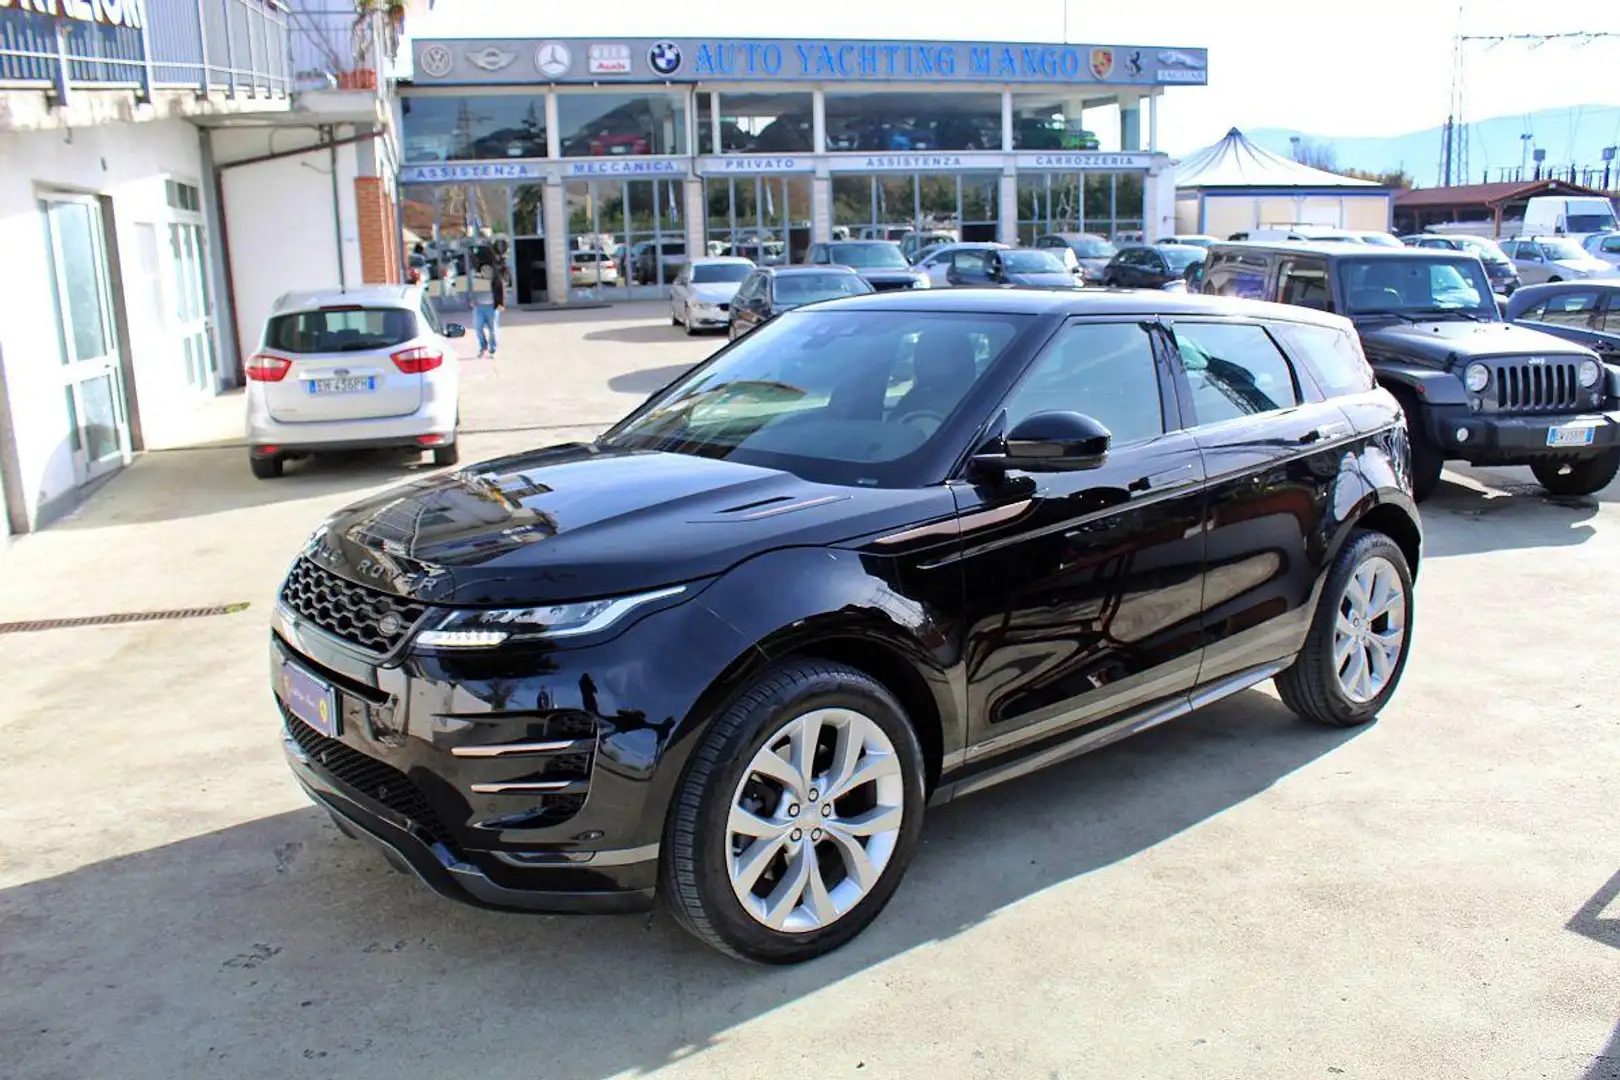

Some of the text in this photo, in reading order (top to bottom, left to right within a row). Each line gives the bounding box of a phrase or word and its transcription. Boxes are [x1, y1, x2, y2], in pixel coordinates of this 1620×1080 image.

[695, 43, 1079, 77] AUTO YACHTING MANGO
[725, 158, 795, 169] PRIVATO
[866, 157, 962, 167] ASSISTENZA
[1036, 155, 1134, 165] CARROZZERIA
[416, 165, 529, 179] ASSISTENZA
[573, 160, 676, 174] MECCANICA
